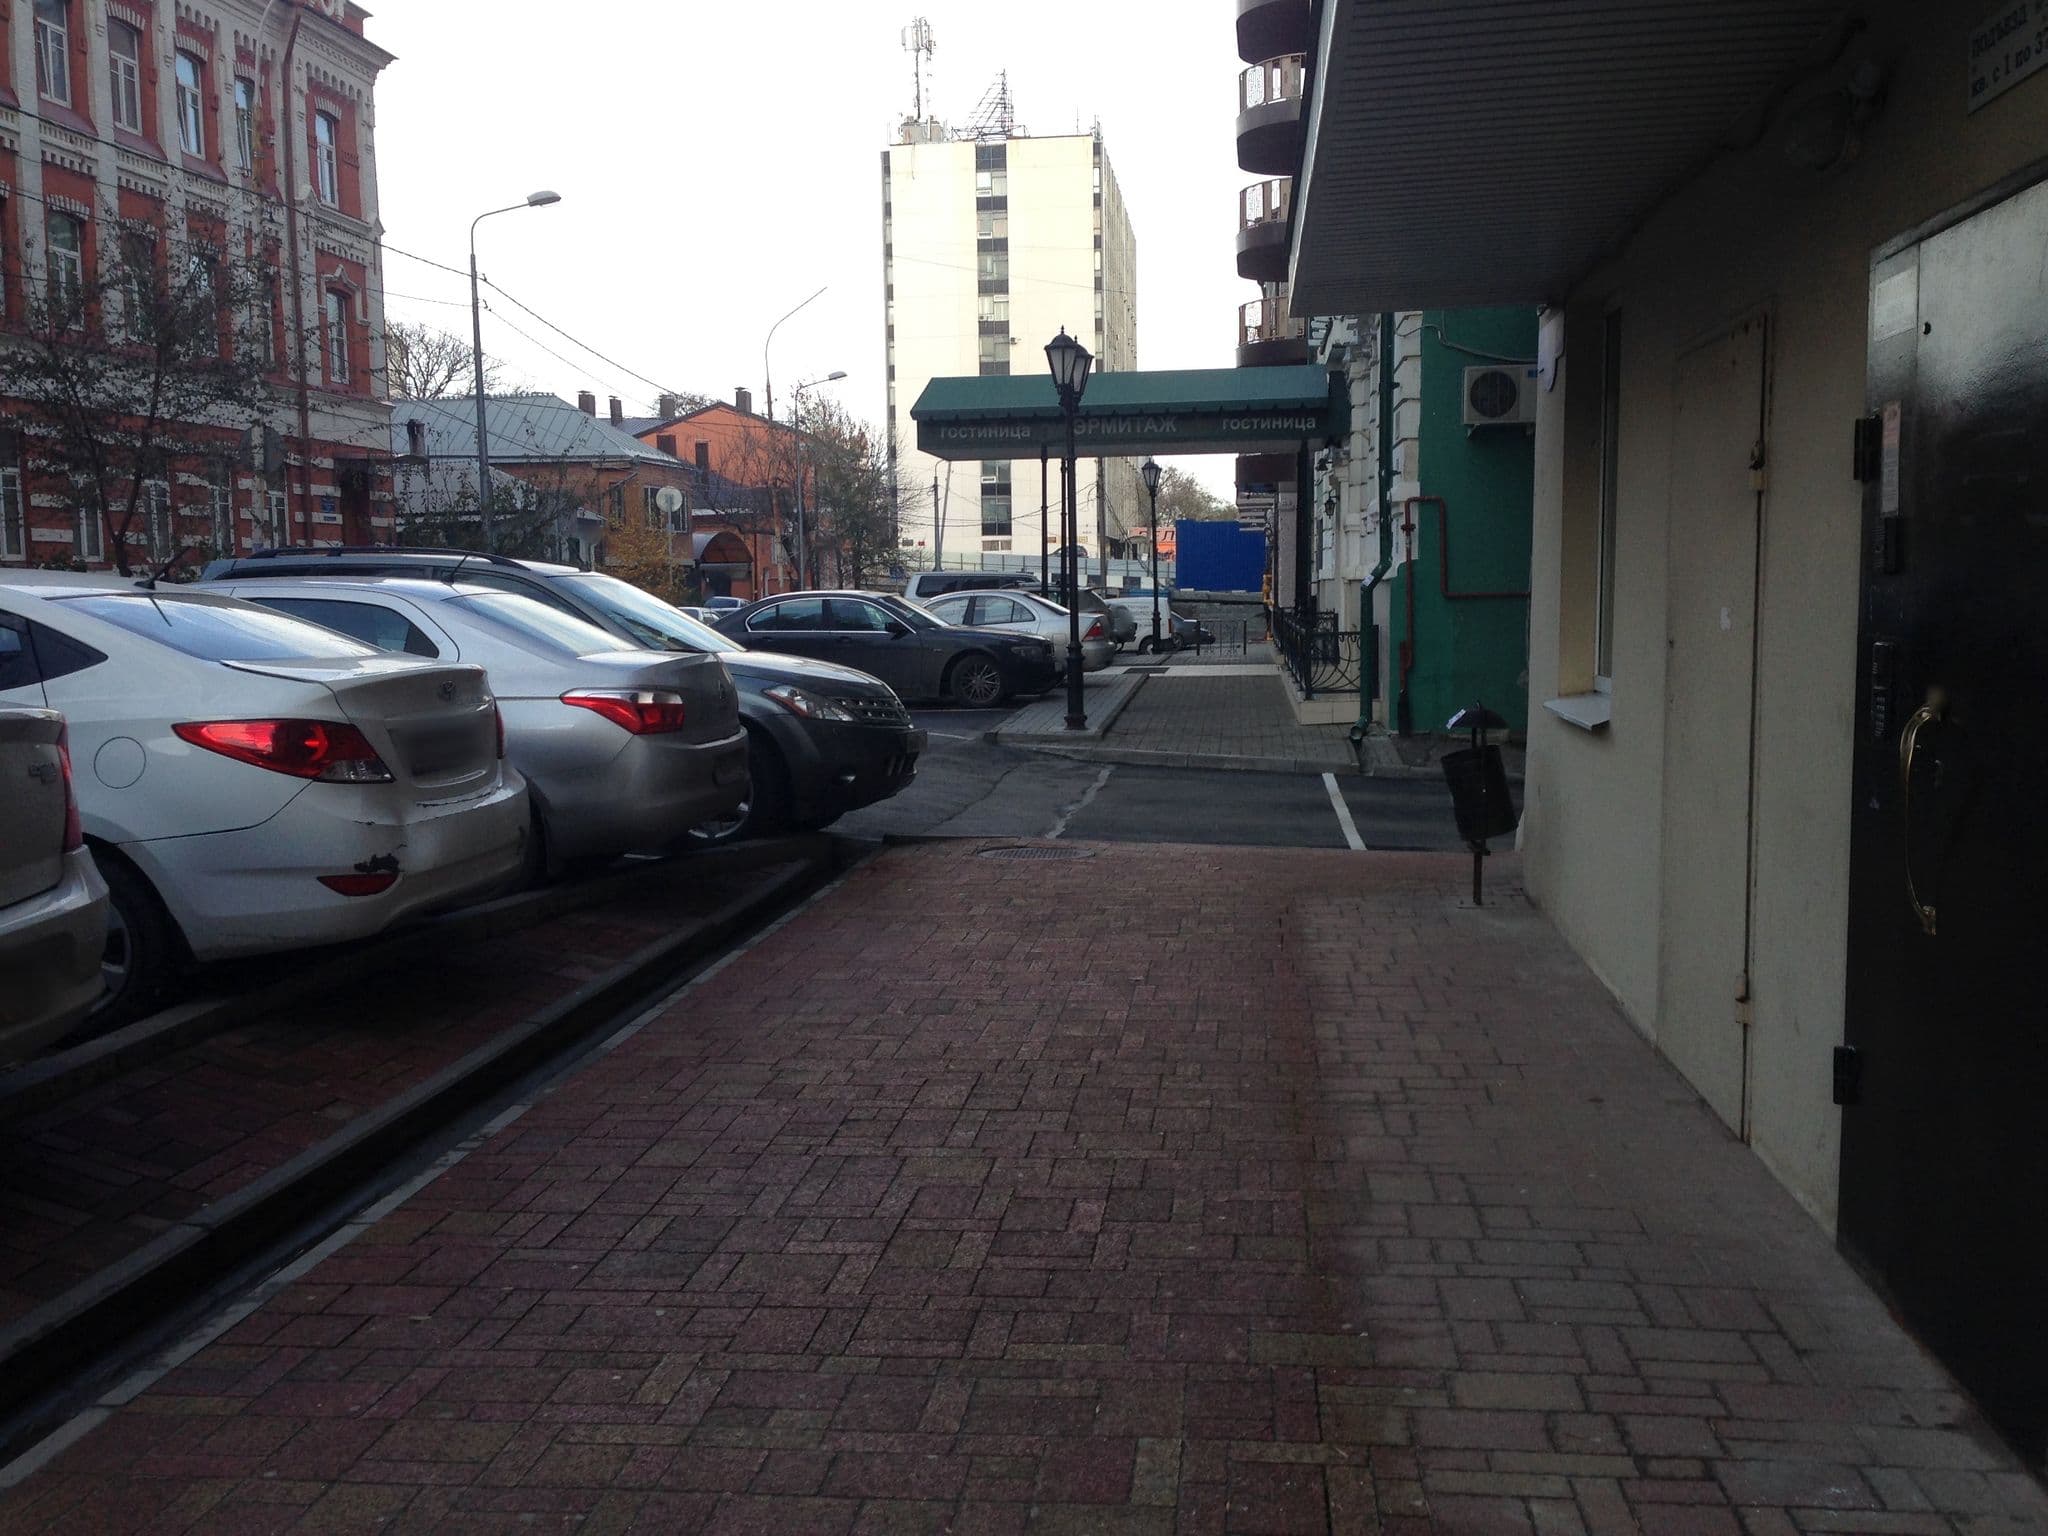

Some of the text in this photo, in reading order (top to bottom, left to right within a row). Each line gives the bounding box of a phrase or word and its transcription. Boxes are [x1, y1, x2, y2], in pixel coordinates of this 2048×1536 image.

[2015, 46, 2031, 69] по
[1073, 416, 1177, 436] ЭРМИТАЖ
[1222, 416, 1316, 431] гостиница
